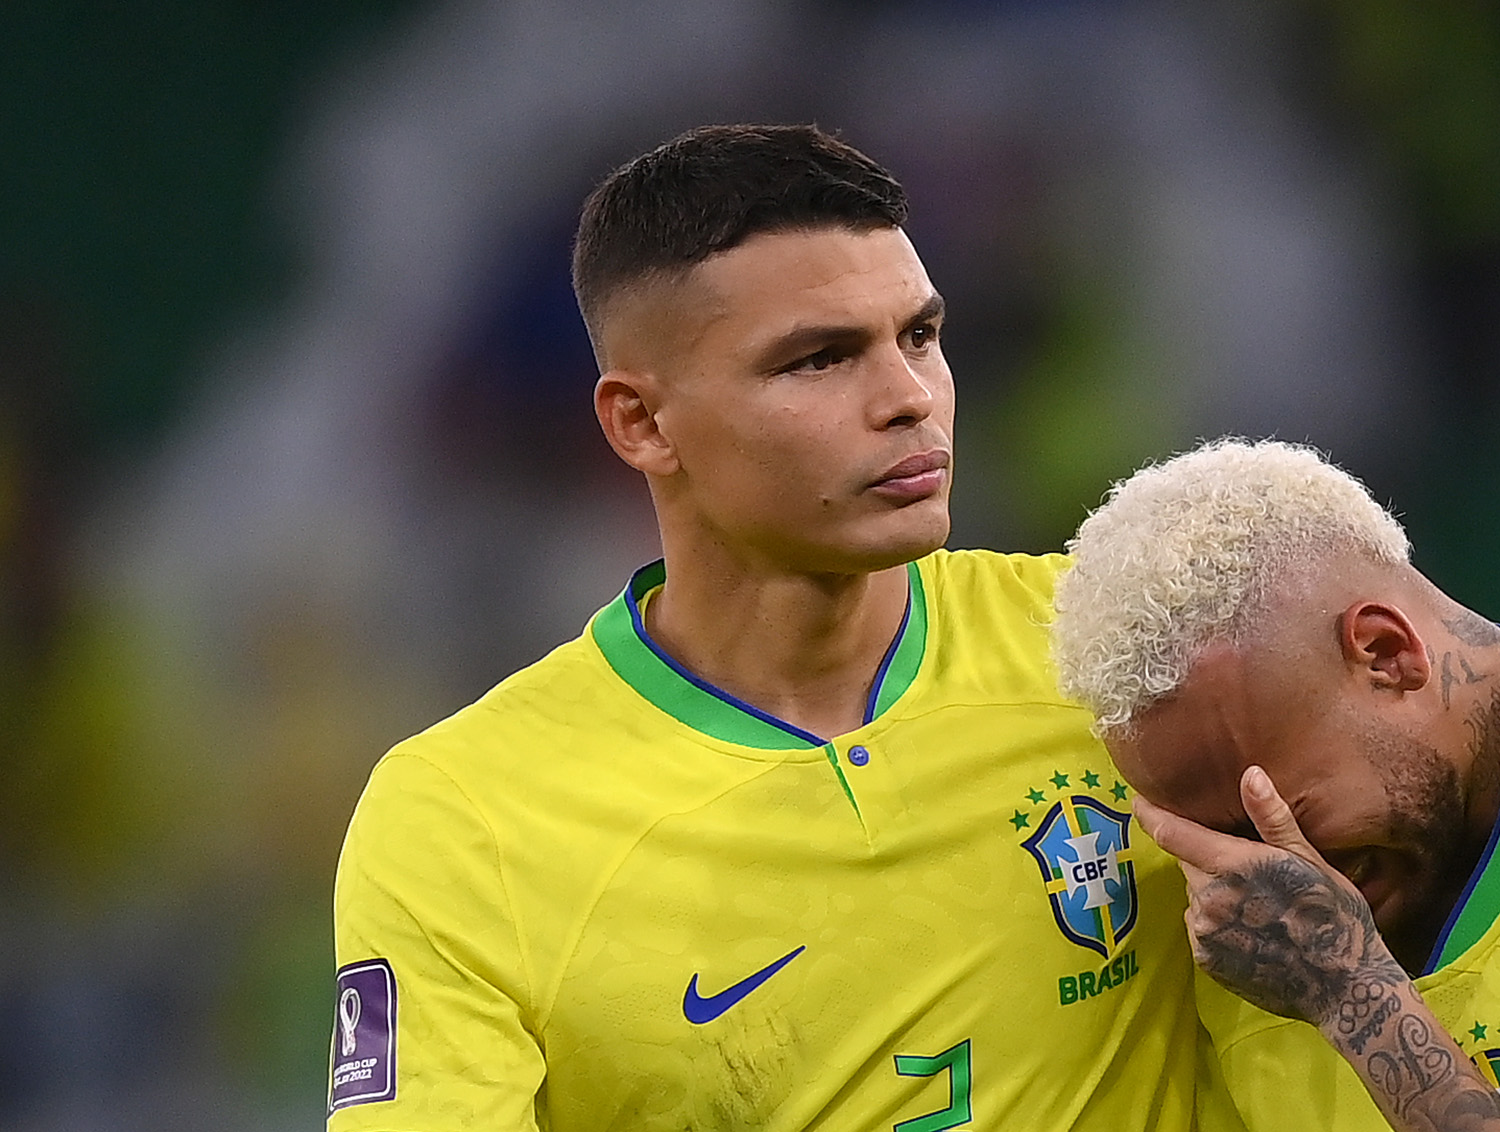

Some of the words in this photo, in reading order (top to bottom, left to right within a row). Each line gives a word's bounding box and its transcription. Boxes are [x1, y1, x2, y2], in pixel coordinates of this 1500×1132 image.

[1072, 858, 1108, 883] CBF
[1058, 950, 1140, 1006] BRASIL
[361, 1057, 378, 1069] CUP
